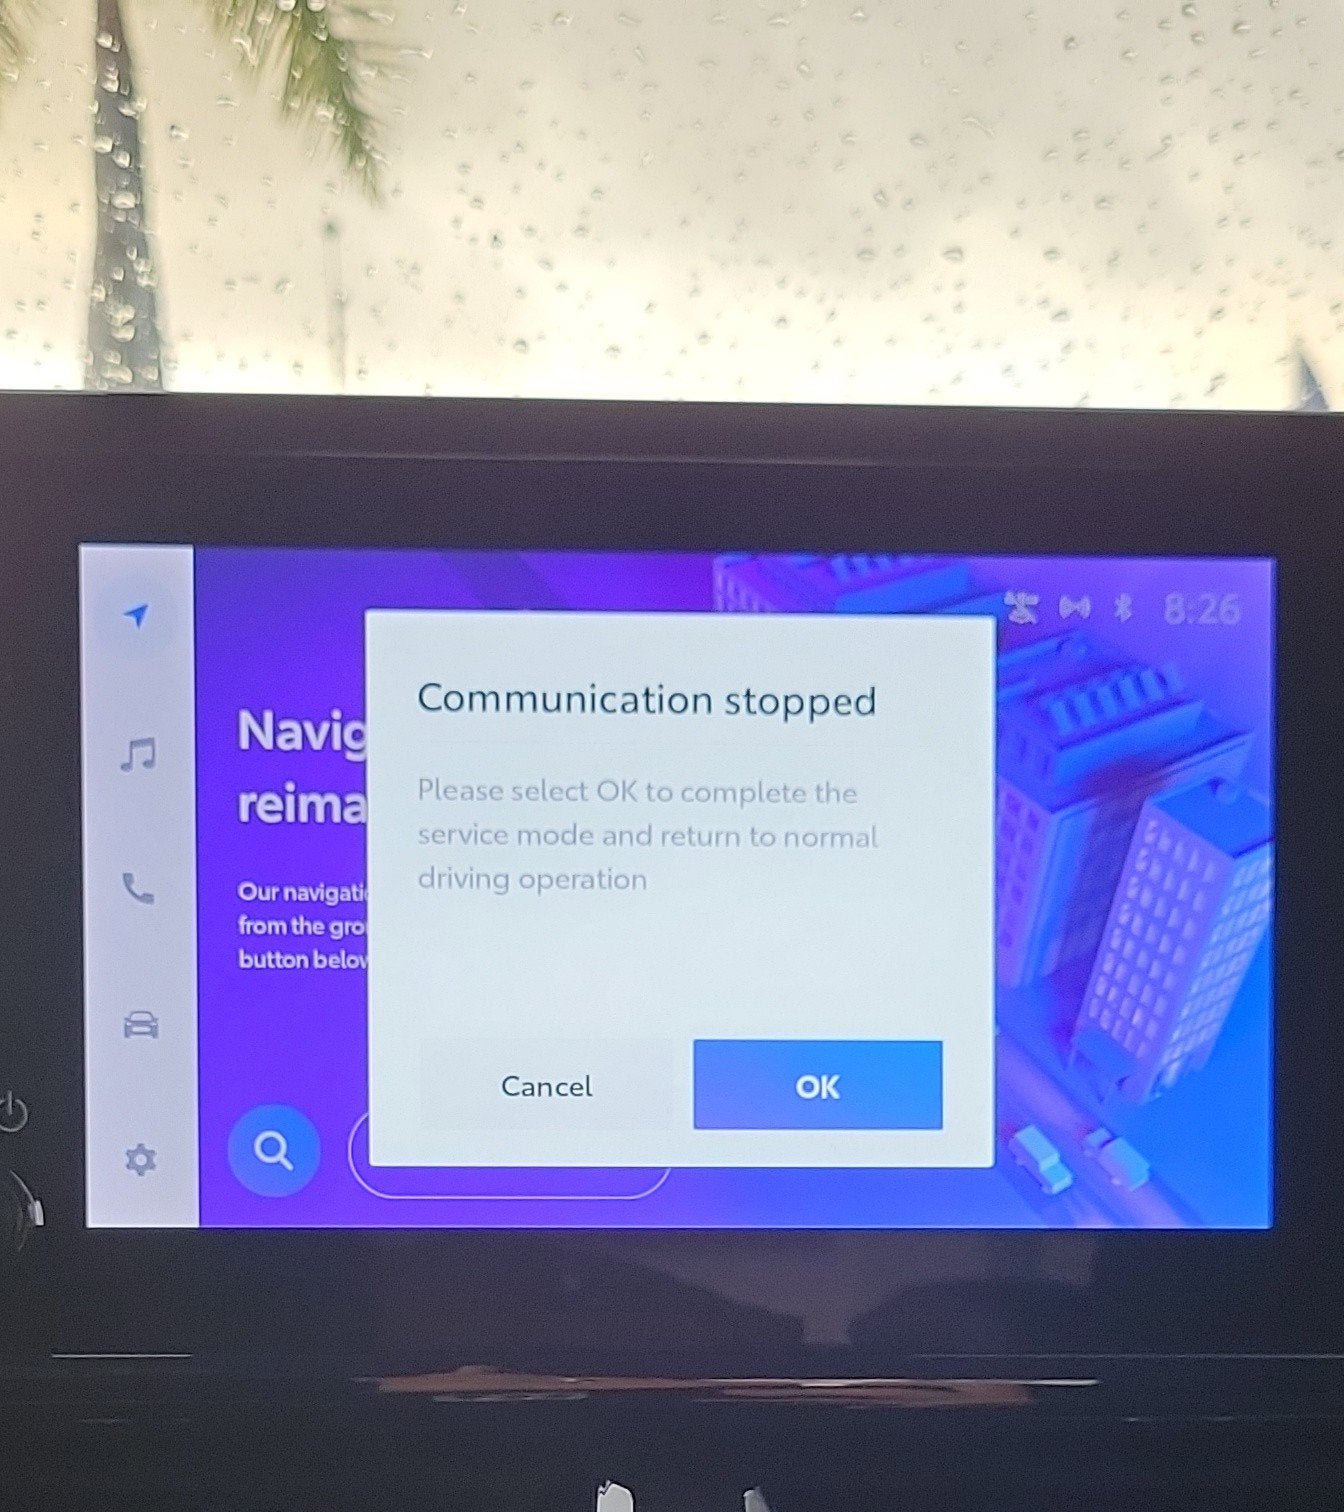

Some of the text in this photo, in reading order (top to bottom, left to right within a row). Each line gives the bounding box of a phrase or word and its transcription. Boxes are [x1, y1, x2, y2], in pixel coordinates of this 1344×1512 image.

[1164, 592, 1242, 625] 8:26
[418, 682, 876, 724] Communication stopped
[418, 777, 859, 810] Please select OK to complete the
[418, 823, 879, 849] service mode and return to normal
[237, 881, 368, 906] Our navigati
[418, 865, 647, 897] driving operation
[238, 913, 288, 936] from
[291, 914, 326, 936] the
[238, 948, 310, 969] button
[501, 1074, 594, 1099] Cancel
[794, 1074, 842, 1101] OK
